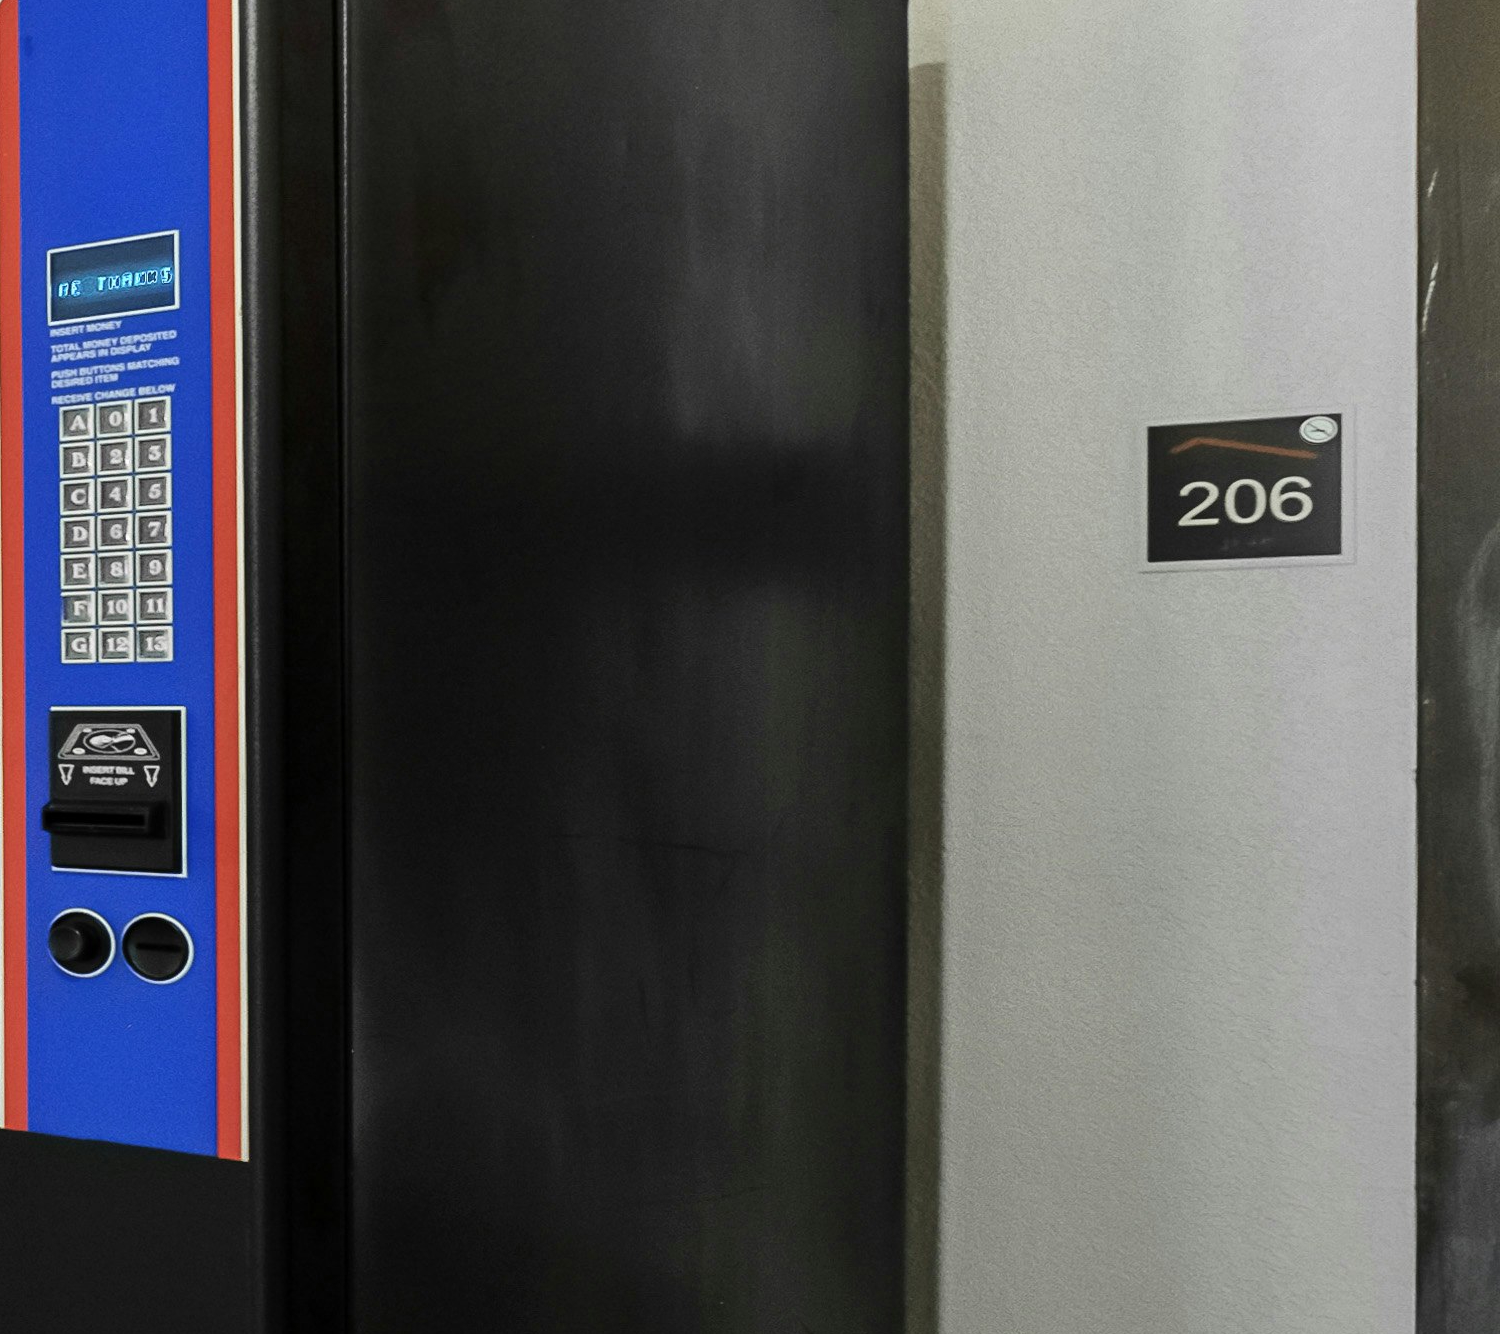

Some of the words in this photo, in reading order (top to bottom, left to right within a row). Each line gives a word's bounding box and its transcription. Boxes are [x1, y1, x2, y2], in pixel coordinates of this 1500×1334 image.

[50, 325, 85, 337] INSERT
[86, 321, 122, 333] MONEY
[51, 342, 81, 354] TOTAL
[82, 337, 119, 349] MONEY
[119, 330, 178, 345] DEPOSITED
[51, 349, 97, 363] APPEARS
[97, 348, 109, 358] IN
[110, 343, 152, 356] DISPLAY
[51, 369, 78, 380] PUSH
[79, 363, 126, 377] BUTTONS
[127, 356, 180, 371] MATCHING
[51, 376, 94, 389] DESIRED
[95, 373, 119, 384] ITEM
[51, 392, 93, 405] RECEIVE
[94, 387, 137, 400] CHANGE
[138, 383, 176, 396] BELOW
[70, 415, 86, 430] A
[109, 411, 122, 427] 0
[148, 407, 158, 423] 1
[71, 452, 85, 468] B
[109, 448, 122, 465] 2
[148, 445, 161, 461] 3
[71, 489, 86, 505] C
[109, 486, 122, 502] 4
[148, 483, 162, 499] 5
[1178, 475, 1314, 527] 206
[72, 526, 88, 542] D
[109, 523, 122, 539] 6
[148, 521, 161, 537] 7
[72, 563, 87, 579] E
[110, 561, 123, 577] 8
[149, 559, 163, 575] 9
[73, 601, 88, 616] F
[107, 599, 128, 615] 10
[146, 597, 165, 614] 11
[71, 637, 88, 653] G
[107, 636, 128, 652] 12
[146, 635, 168, 651] 13
[114, 777, 128, 786] UP
